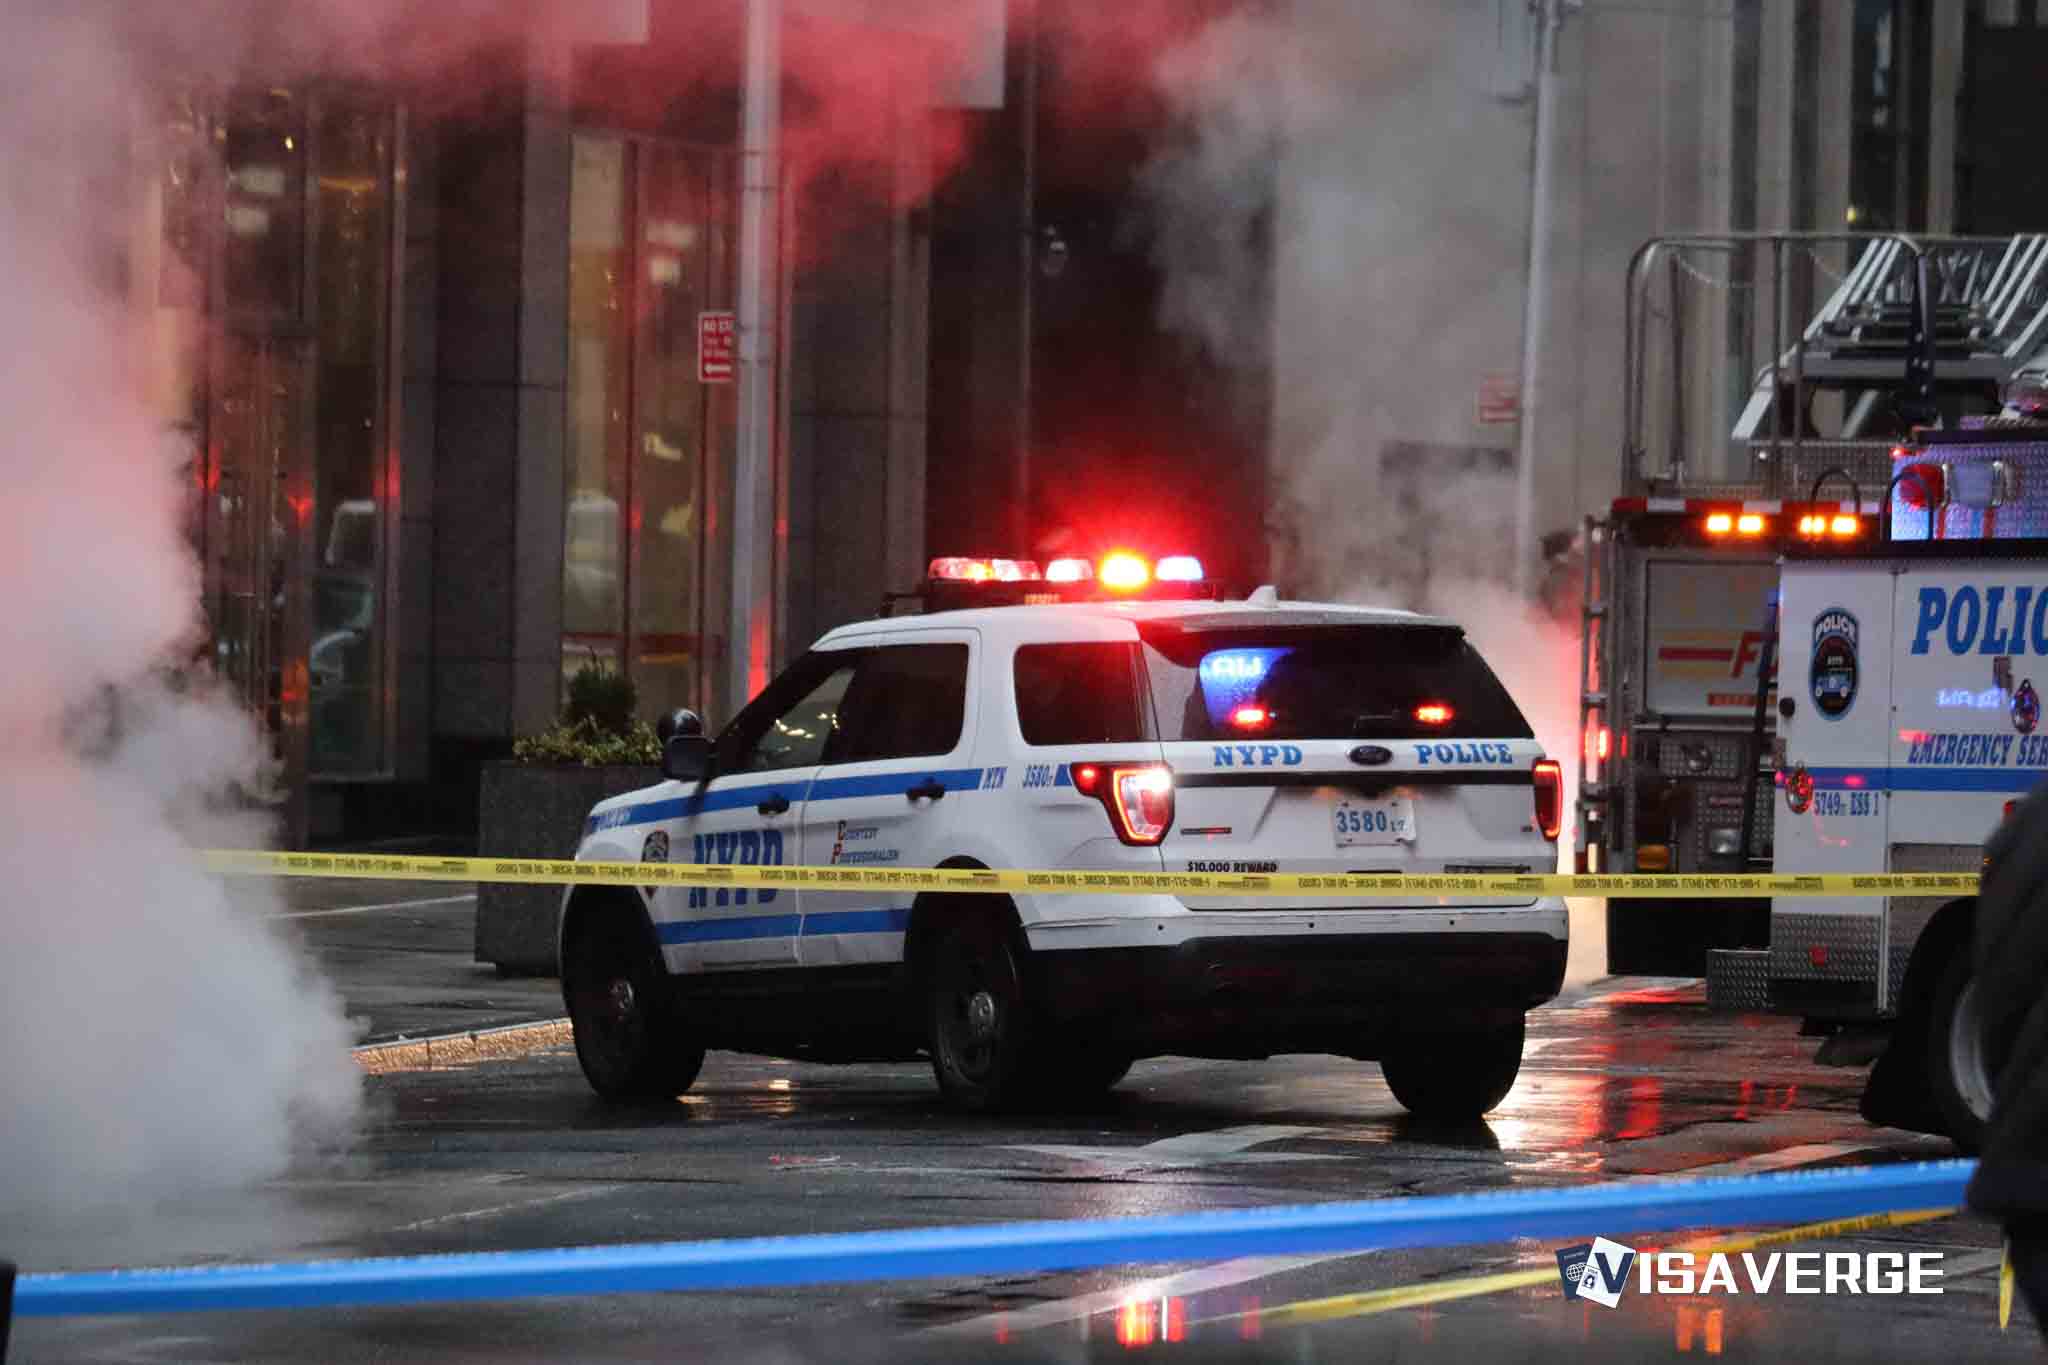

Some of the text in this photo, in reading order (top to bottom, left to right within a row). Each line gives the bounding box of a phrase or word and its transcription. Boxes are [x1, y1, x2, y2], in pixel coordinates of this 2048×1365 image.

[1213, 745, 1303, 767] NYPD
[1414, 743, 1513, 765] POLICE
[1908, 733, 2014, 766] EMERGENCY
[1335, 810, 1387, 832] 3580
[688, 829, 784, 908] NYPD
[1233, 861, 1277, 872] REWARD
